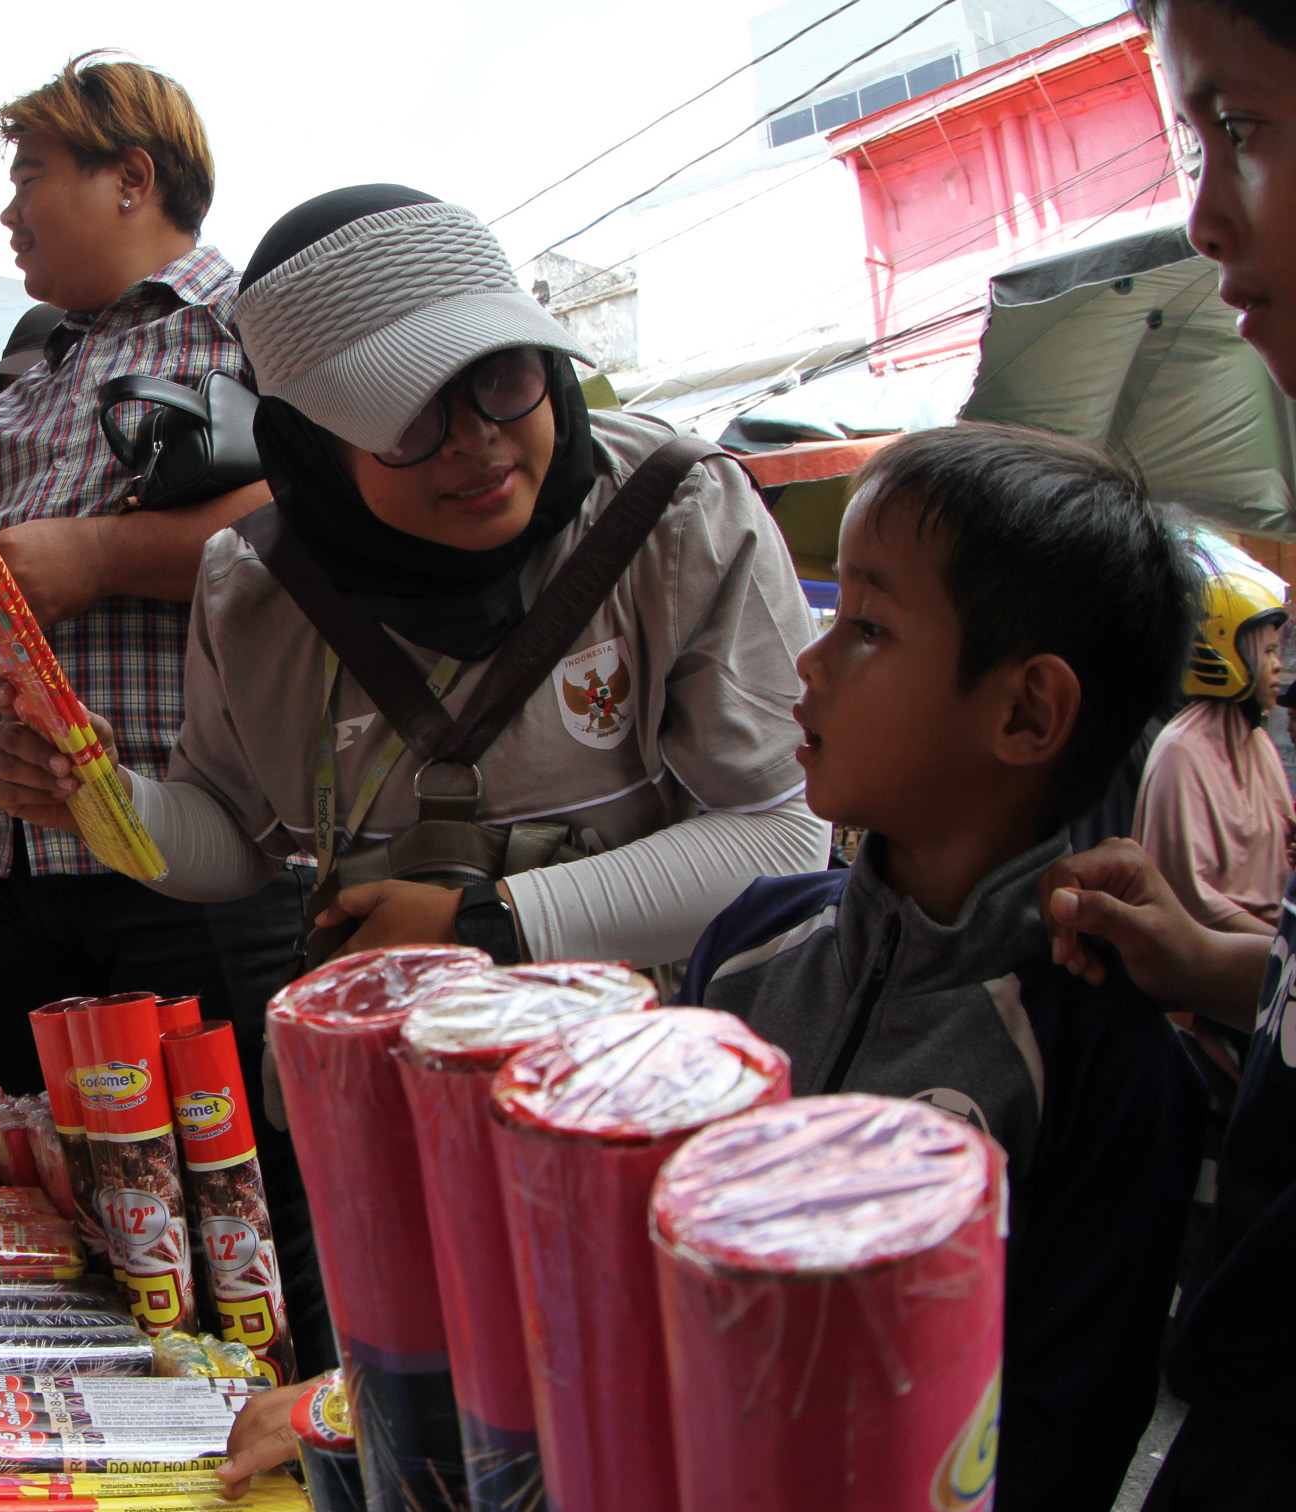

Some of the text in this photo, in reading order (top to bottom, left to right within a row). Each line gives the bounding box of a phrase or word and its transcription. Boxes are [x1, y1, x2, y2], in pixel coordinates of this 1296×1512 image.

[564, 645, 614, 668] INDONESIA
[318, 787, 332, 850] FreshCare
[100, 1072, 137, 1087] omet
[110, 1462, 128, 1473] DO
[133, 1462, 160, 1473] NOT
[164, 1460, 200, 1472] HOLD
